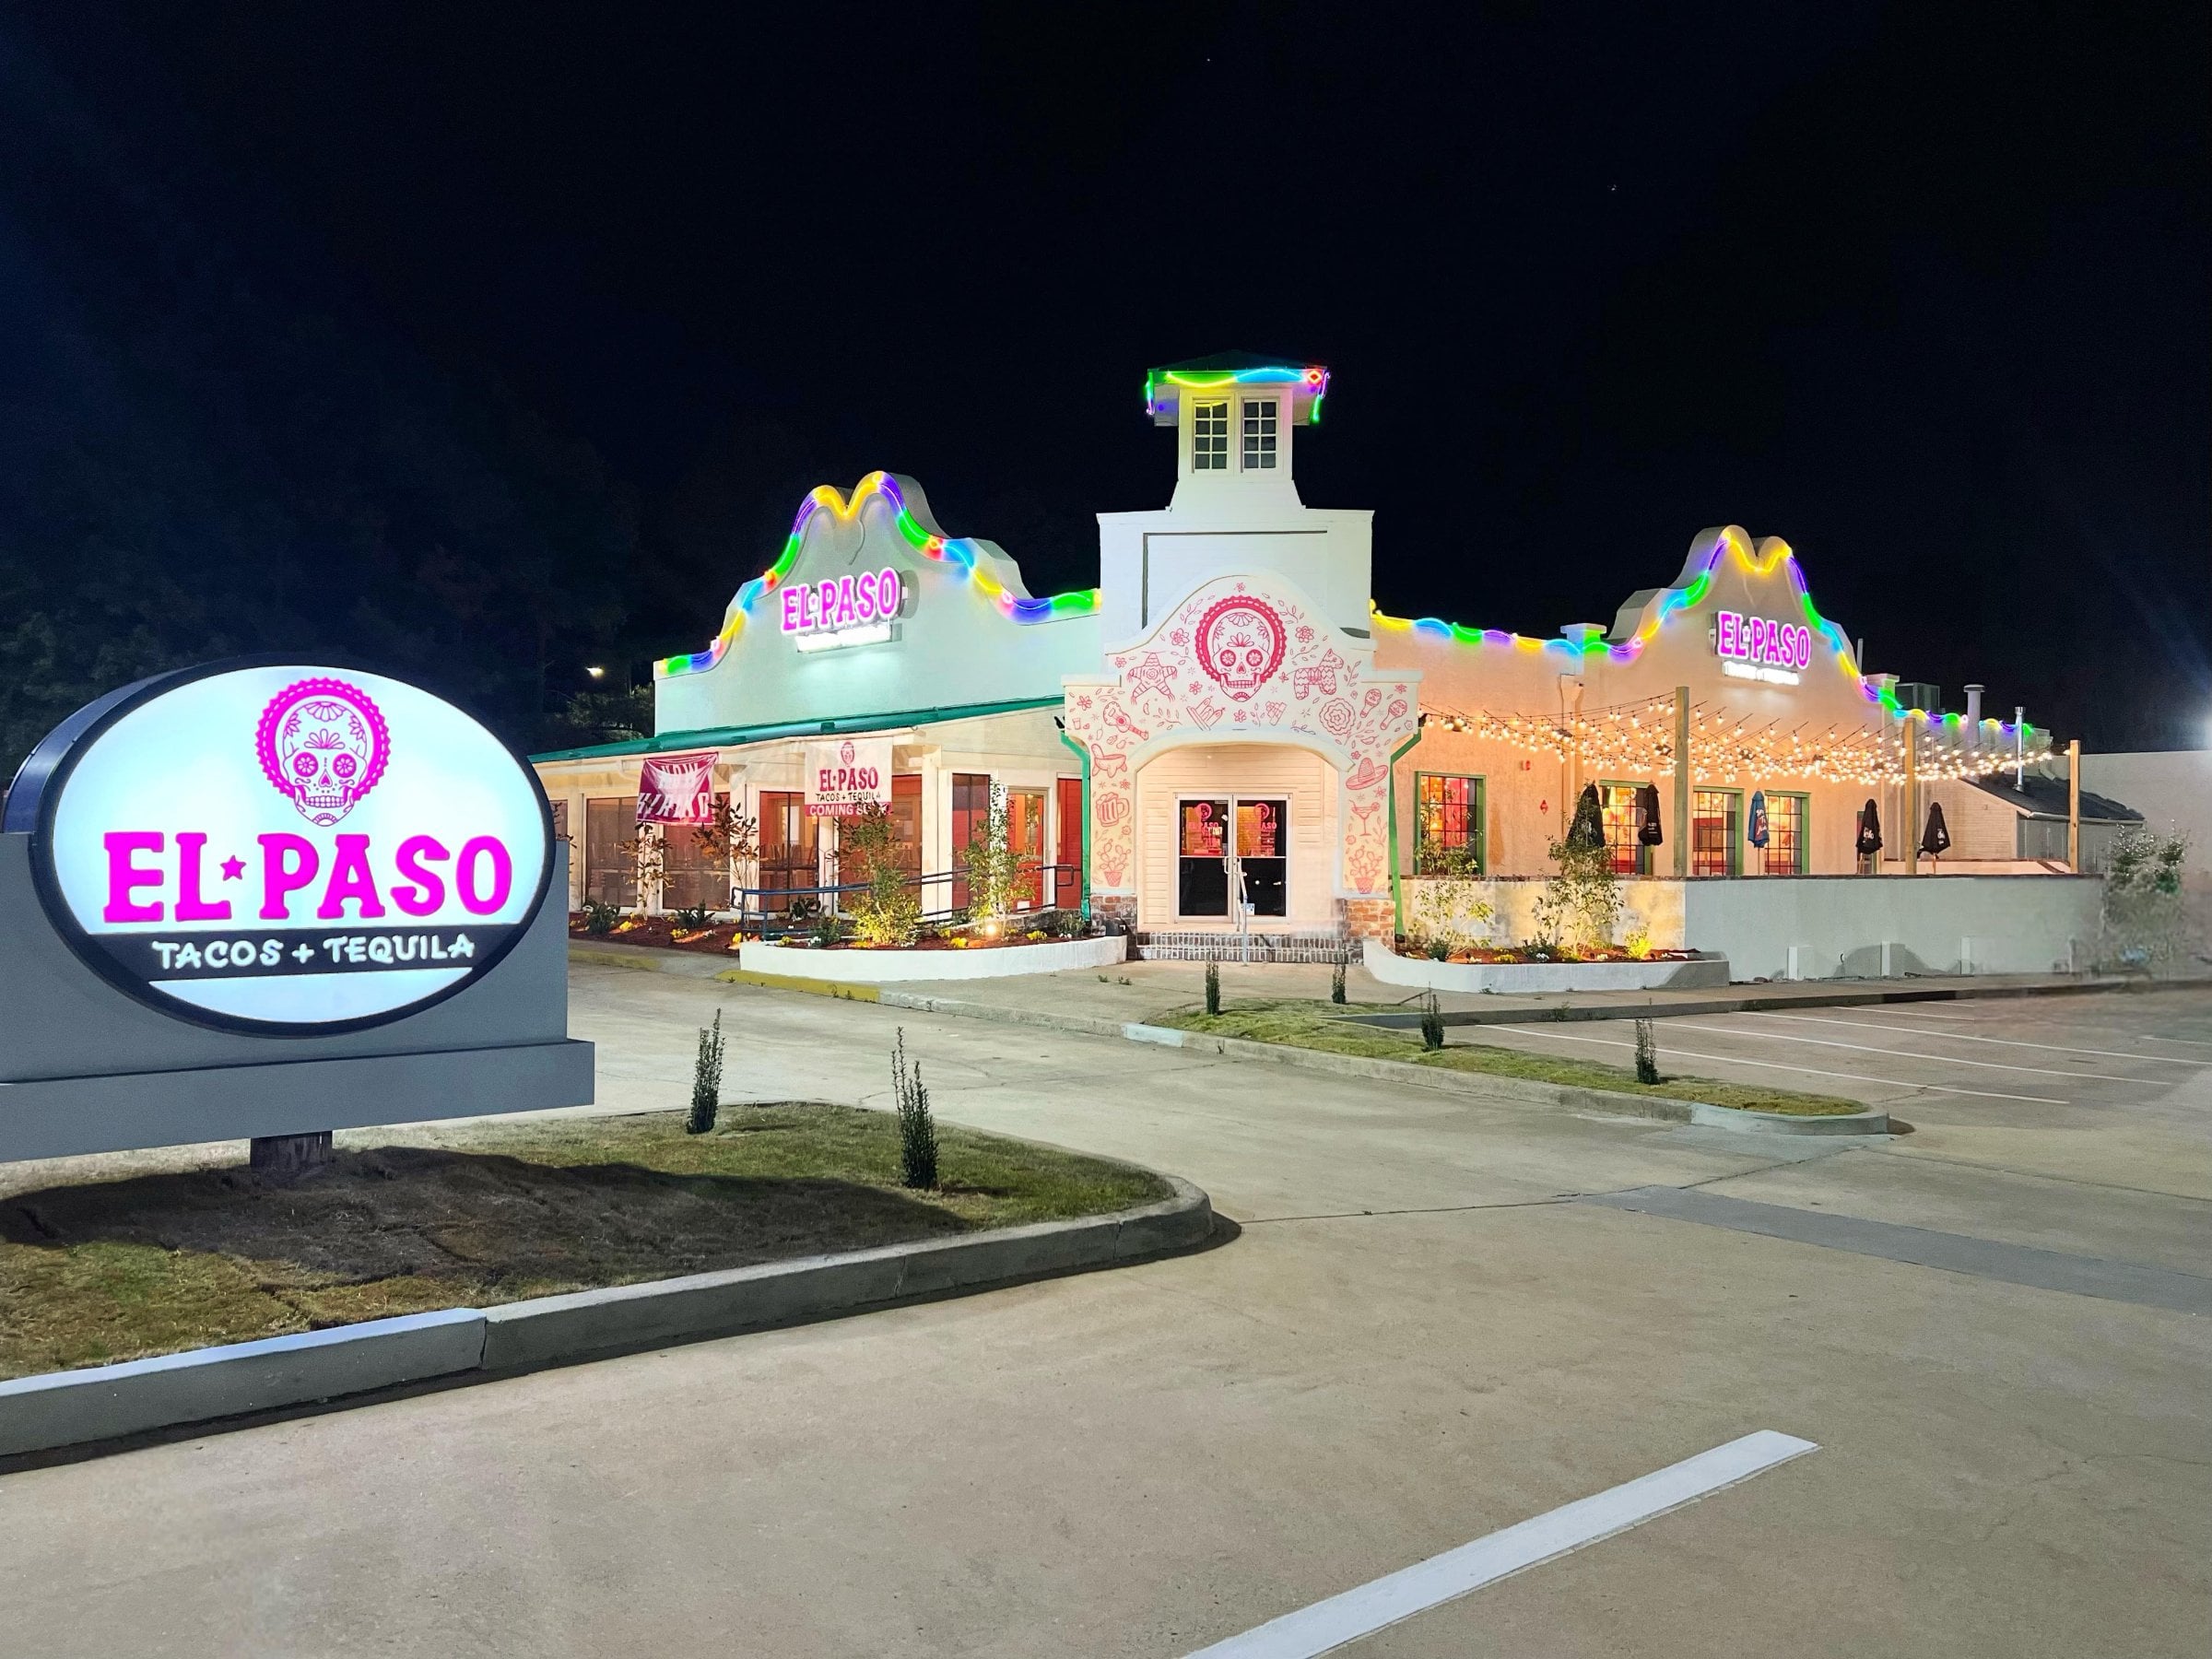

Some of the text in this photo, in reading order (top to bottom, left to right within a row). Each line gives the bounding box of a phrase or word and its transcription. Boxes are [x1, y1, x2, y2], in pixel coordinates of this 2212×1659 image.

[781, 568, 900, 632] EL PASO
[1719, 612, 1810, 668] EL PASO
[816, 793, 840, 802] TACOS
[848, 792, 881, 802] TEQUILA
[819, 767, 878, 792] EL PASO
[810, 804, 855, 816] COMING
[103, 831, 512, 923] EL PASO
[151, 939, 284, 969] TACOS
[323, 933, 476, 965] TEQUILA
